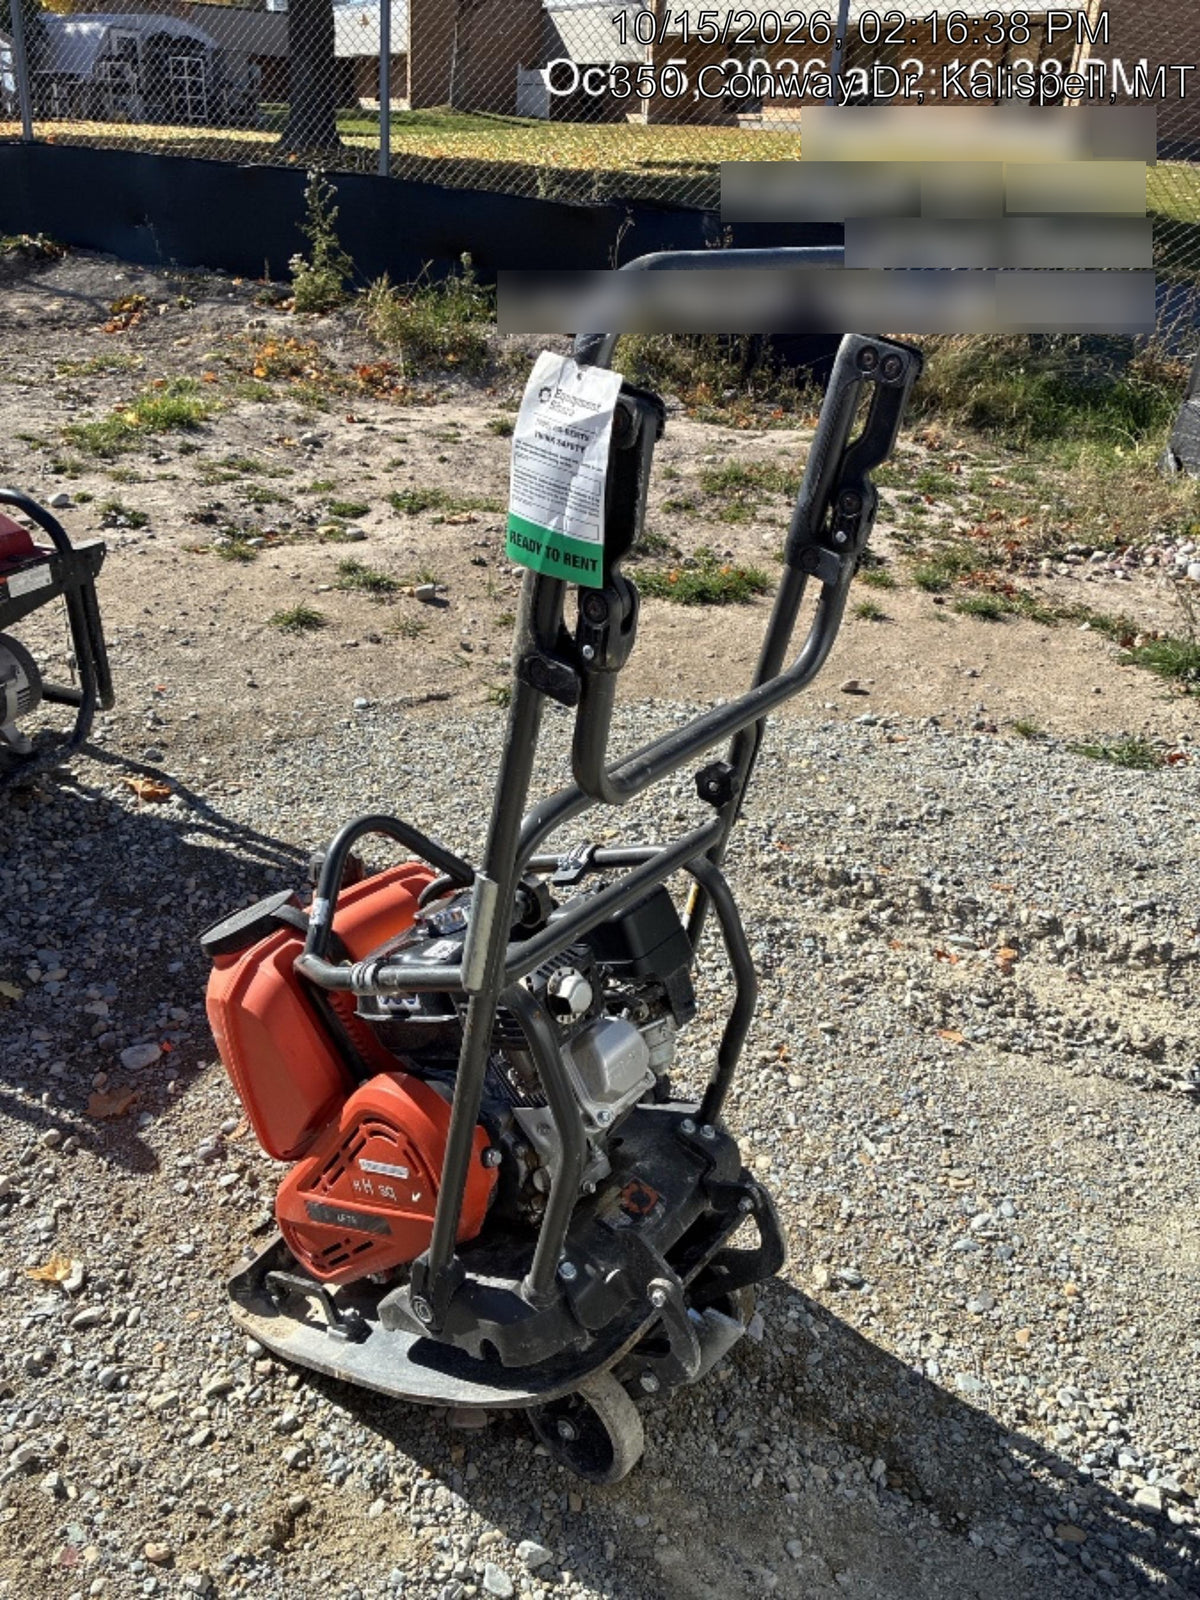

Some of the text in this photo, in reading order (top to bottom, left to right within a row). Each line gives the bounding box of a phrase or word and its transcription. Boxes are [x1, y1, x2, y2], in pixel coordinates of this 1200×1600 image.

[509, 531, 598, 573] READY TO RENT
